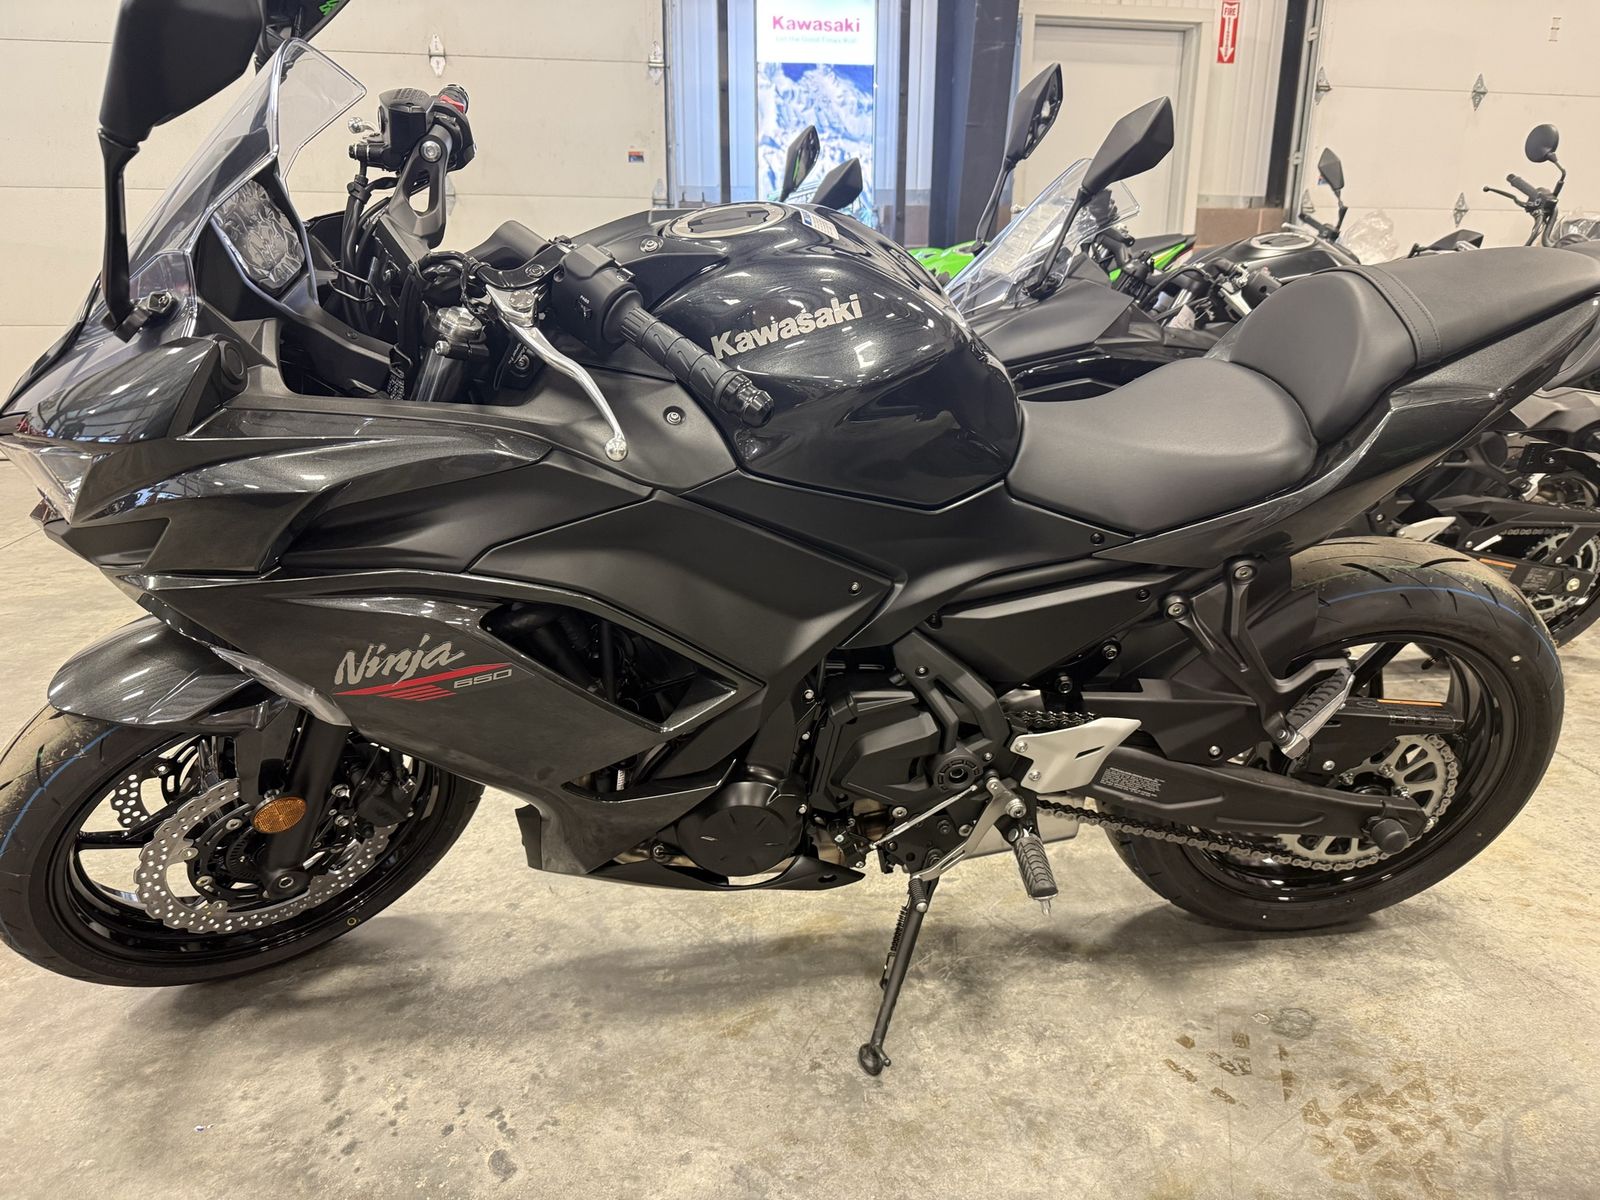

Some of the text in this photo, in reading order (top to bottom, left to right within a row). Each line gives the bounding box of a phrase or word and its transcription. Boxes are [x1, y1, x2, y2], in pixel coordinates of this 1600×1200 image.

[1224, 7, 1236, 16] FIRE
[772, 16, 860, 32] Kawasaki
[710, 293, 863, 360] Kawasaki
[334, 633, 466, 687] Ninja
[453, 668, 512, 689] 650
